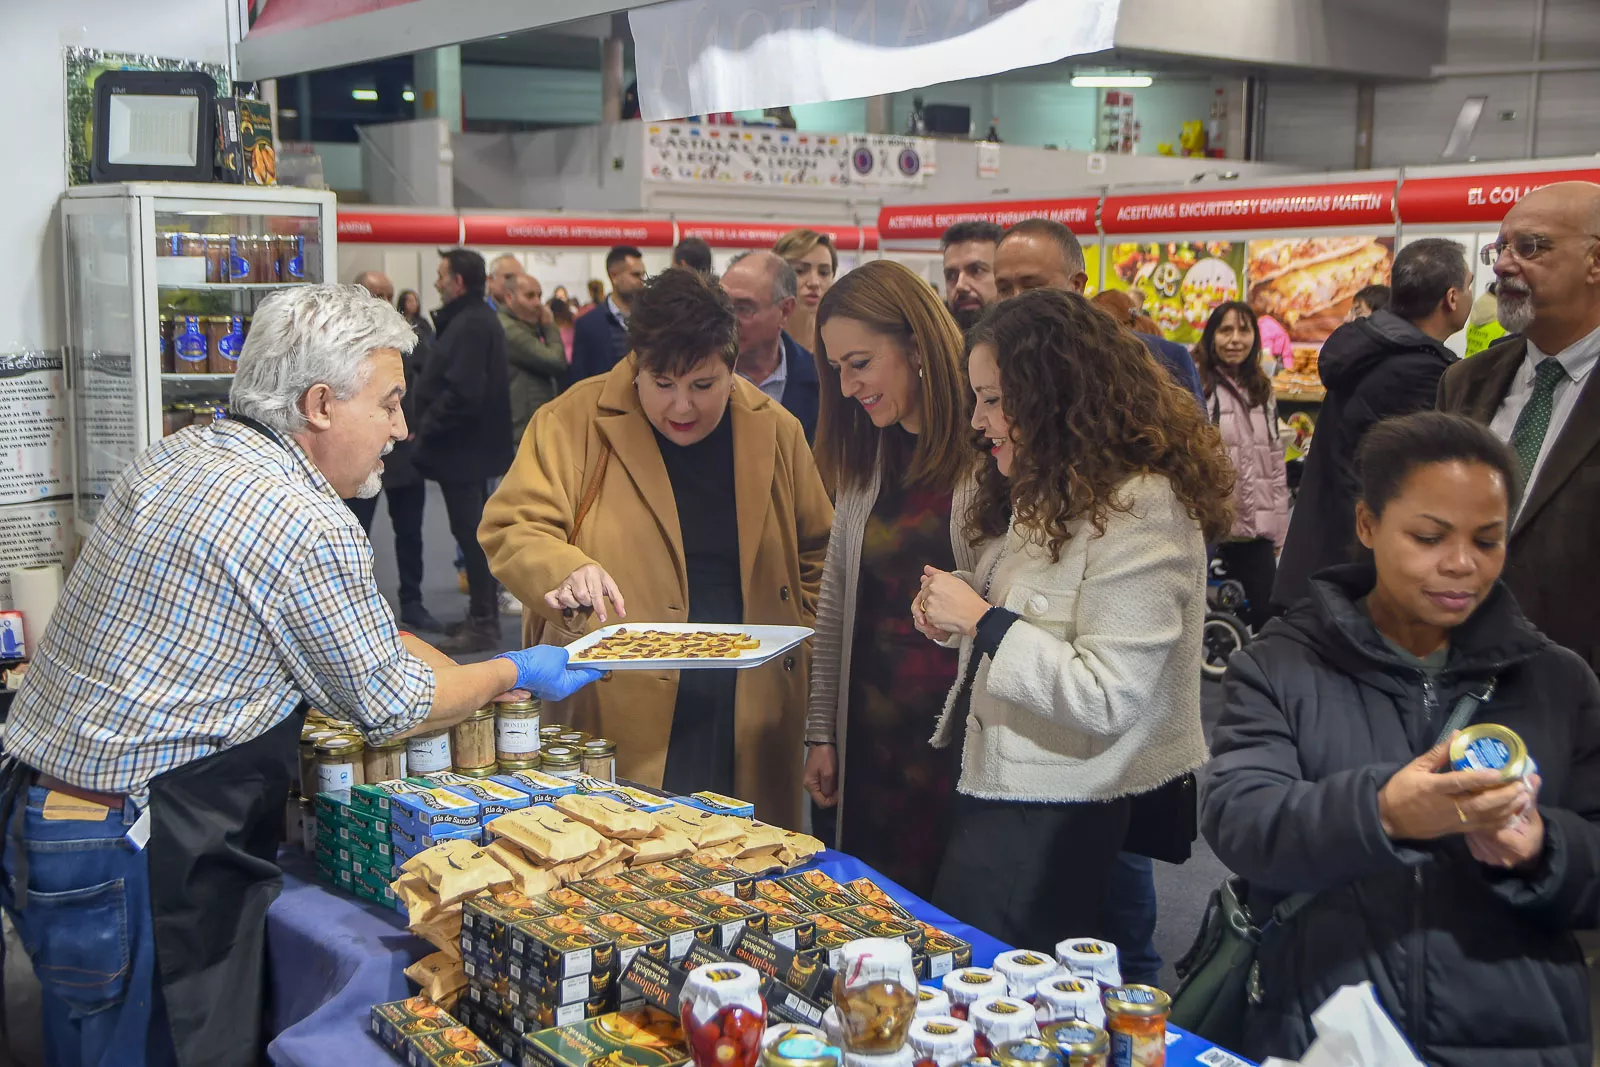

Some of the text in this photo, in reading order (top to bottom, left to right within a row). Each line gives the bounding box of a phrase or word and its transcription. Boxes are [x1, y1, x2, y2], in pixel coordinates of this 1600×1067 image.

[1179, 199, 1250, 218] ENCURTIDOS
[1259, 195, 1332, 215] EMPANADAS
[1467, 187, 1487, 206] EL
[444, 814, 453, 823] de
[736, 947, 780, 977] Mejillones
[626, 970, 672, 1006] Mejillones
